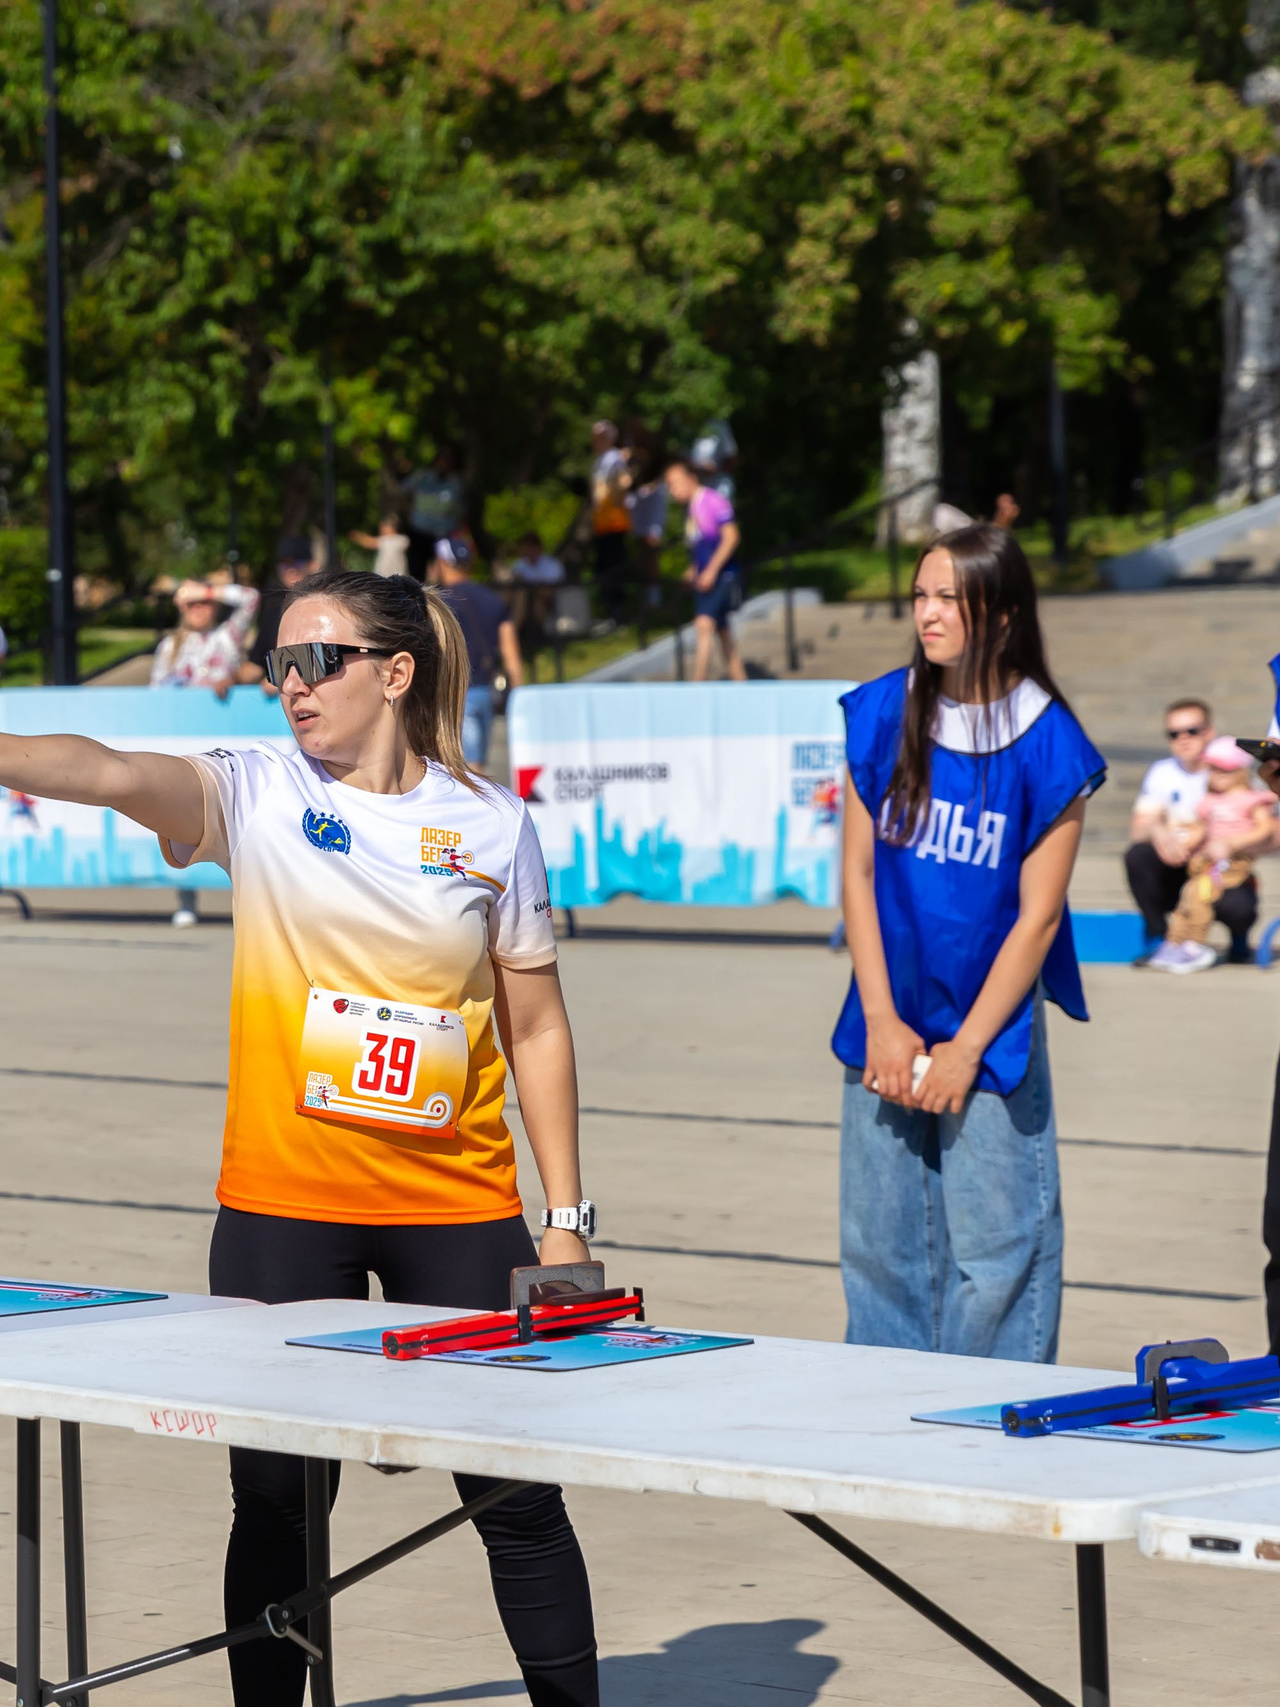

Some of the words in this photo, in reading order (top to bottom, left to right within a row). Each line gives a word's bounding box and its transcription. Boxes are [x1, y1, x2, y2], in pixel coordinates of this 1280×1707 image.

[553, 763, 671, 783] КАЛАШНИКОВ
[420, 827, 462, 848] ЛАЗЕР
[420, 864, 454, 878] 2025
[358, 1033, 415, 1096] 39
[308, 1072, 332, 1085] ЛАЗЕР
[305, 1095, 322, 1108] 2025
